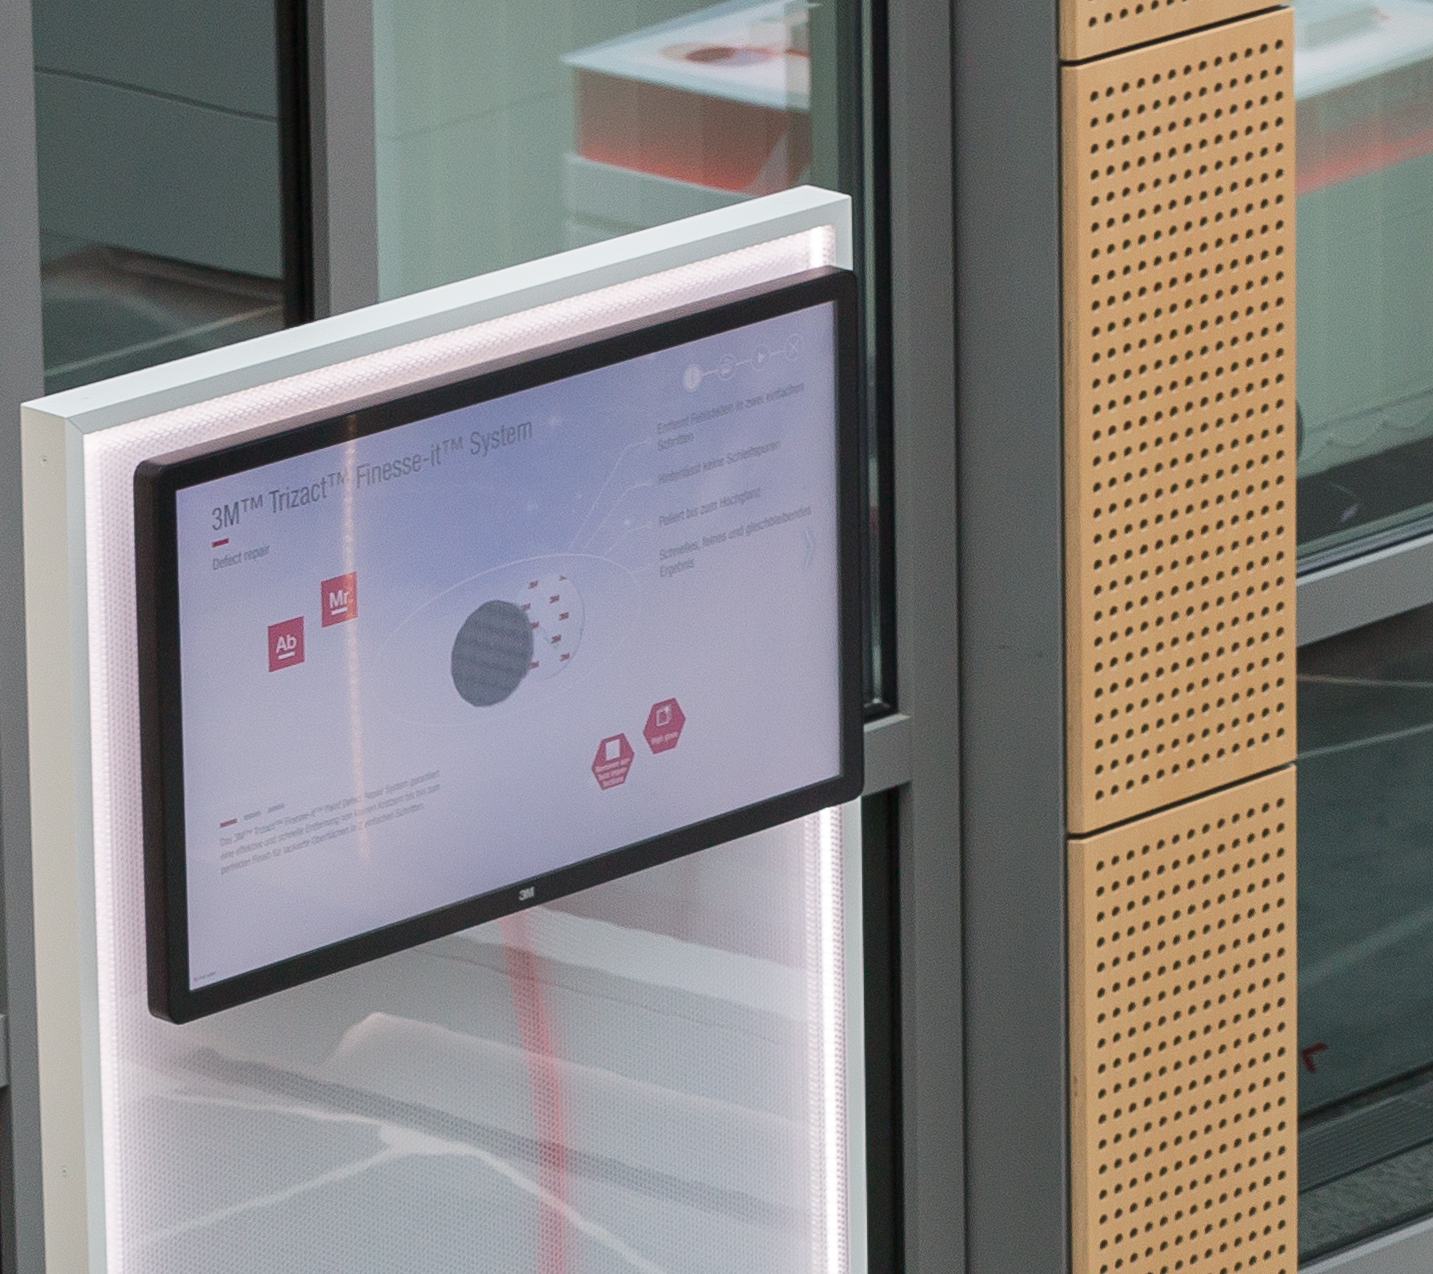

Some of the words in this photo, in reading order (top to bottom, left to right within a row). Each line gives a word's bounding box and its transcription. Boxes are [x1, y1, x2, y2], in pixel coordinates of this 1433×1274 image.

[211, 494, 264, 532] 3M™
[268, 471, 346, 514] Trizact™
[355, 437, 464, 489] Finesse-it™
[469, 421, 533, 457] System
[212, 551, 243, 572] Defect
[244, 543, 270, 564] repair
[329, 590, 349, 609] Mr
[276, 635, 297, 654] Ab
[519, 886, 535, 901] 3M
